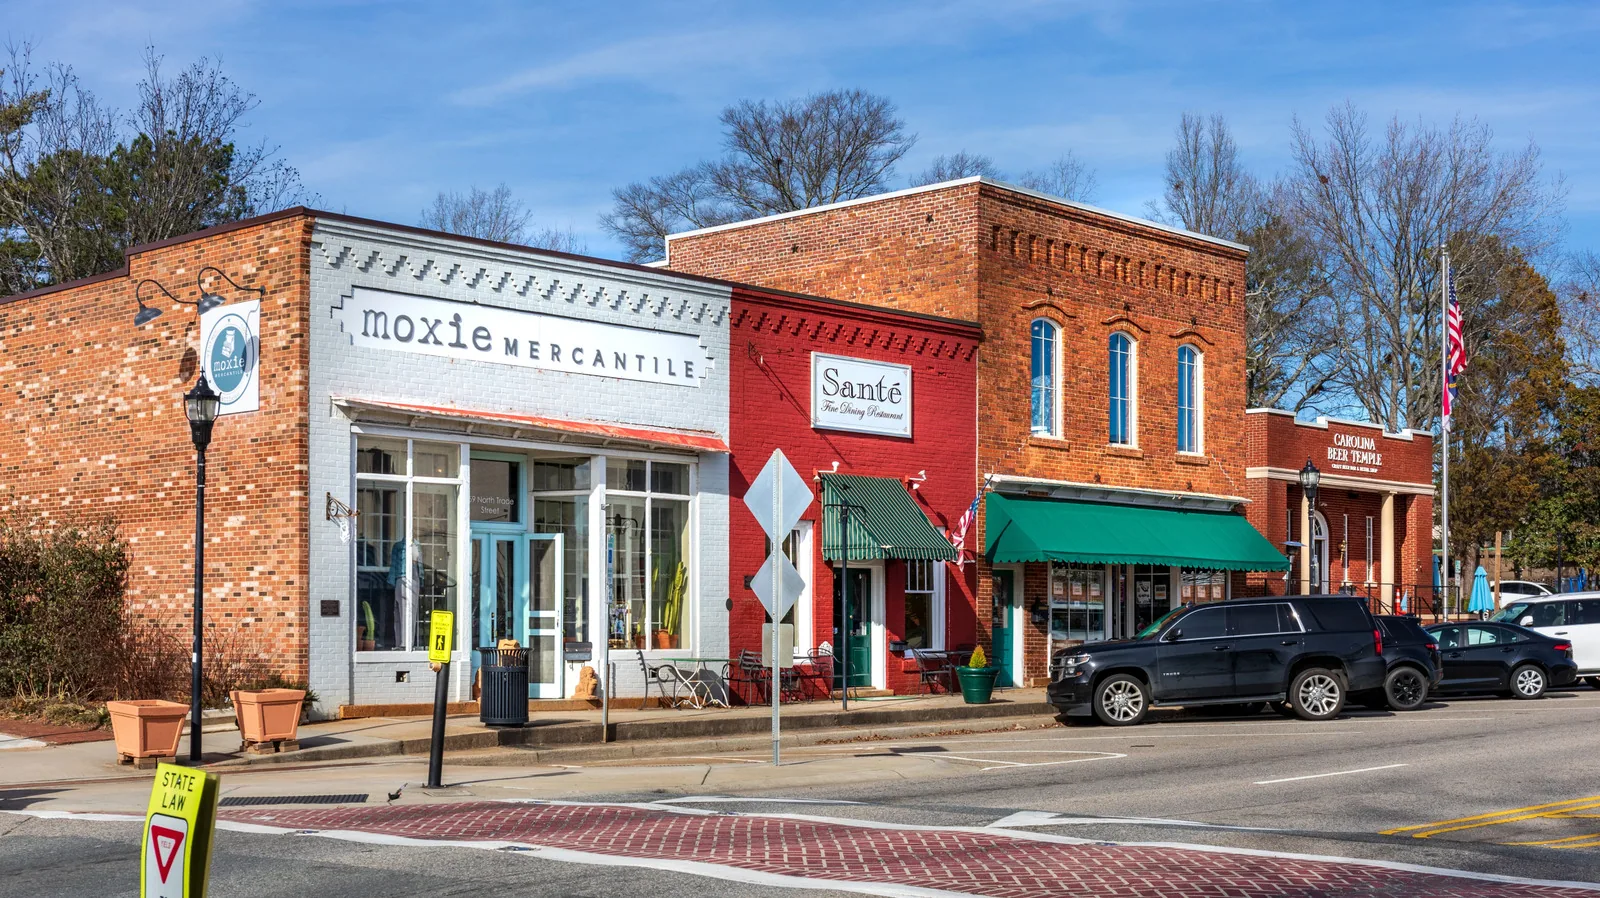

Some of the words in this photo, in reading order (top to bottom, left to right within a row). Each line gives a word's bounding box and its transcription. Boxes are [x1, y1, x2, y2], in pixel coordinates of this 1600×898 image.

[361, 309, 492, 352] moxie
[503, 337, 695, 379] MERCANTILE
[214, 355, 245, 371] moxie
[822, 367, 902, 404] Santé
[821, 399, 839, 412] Fine
[839, 401, 865, 420] Dining
[866, 404, 904, 420] Restaurant
[1333, 433, 1376, 450] CAROLINA
[1327, 446, 1348, 462] BEER
[1351, 450, 1382, 465] TEMPLE
[478, 496, 495, 504] North
[480, 505, 500, 514] Street
[162, 771, 195, 792] STATE
[161, 792, 186, 811] LAW
